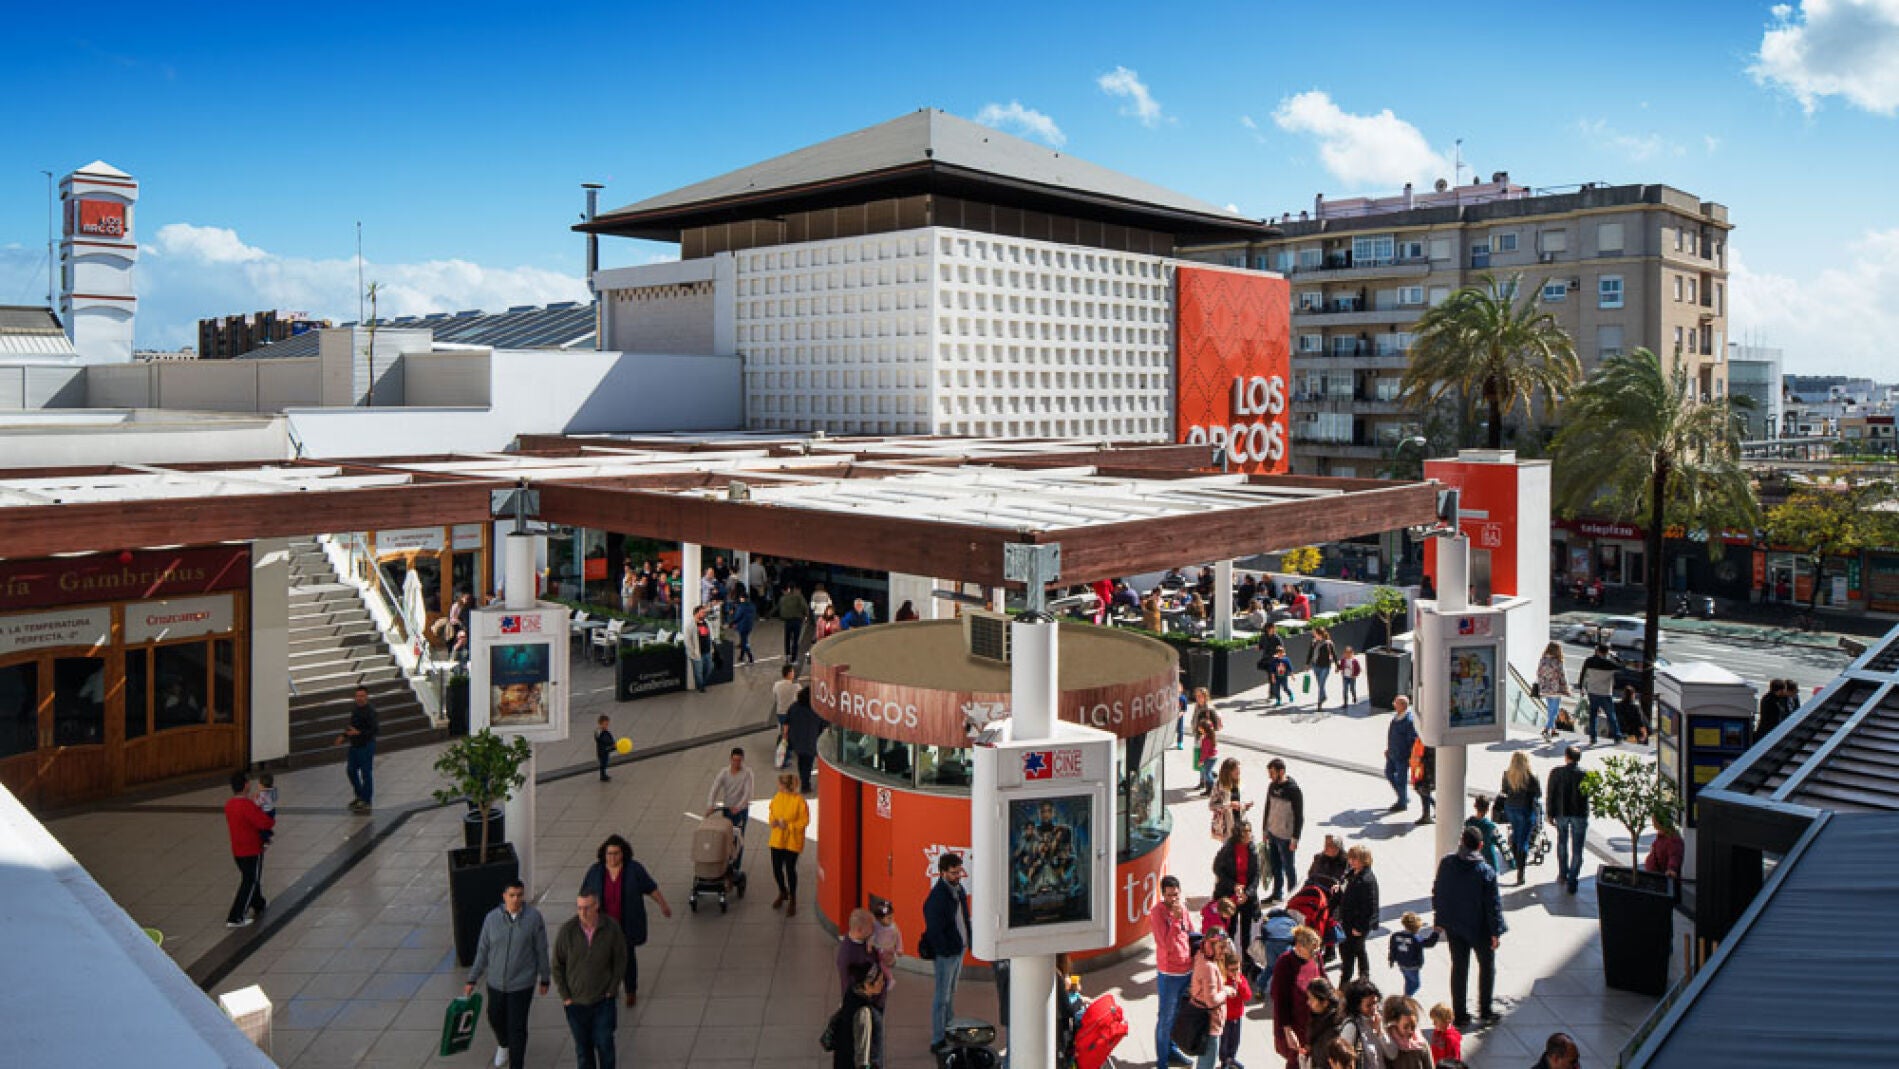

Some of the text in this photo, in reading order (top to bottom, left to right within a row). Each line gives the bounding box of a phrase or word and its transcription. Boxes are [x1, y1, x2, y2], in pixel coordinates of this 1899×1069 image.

[101, 216, 122, 225] LOS
[1235, 375, 1284, 415] LOS
[60, 566, 206, 593] Gambrinus
[840, 690, 919, 728] ARCOS
[1053, 756, 1082, 773] CINE
